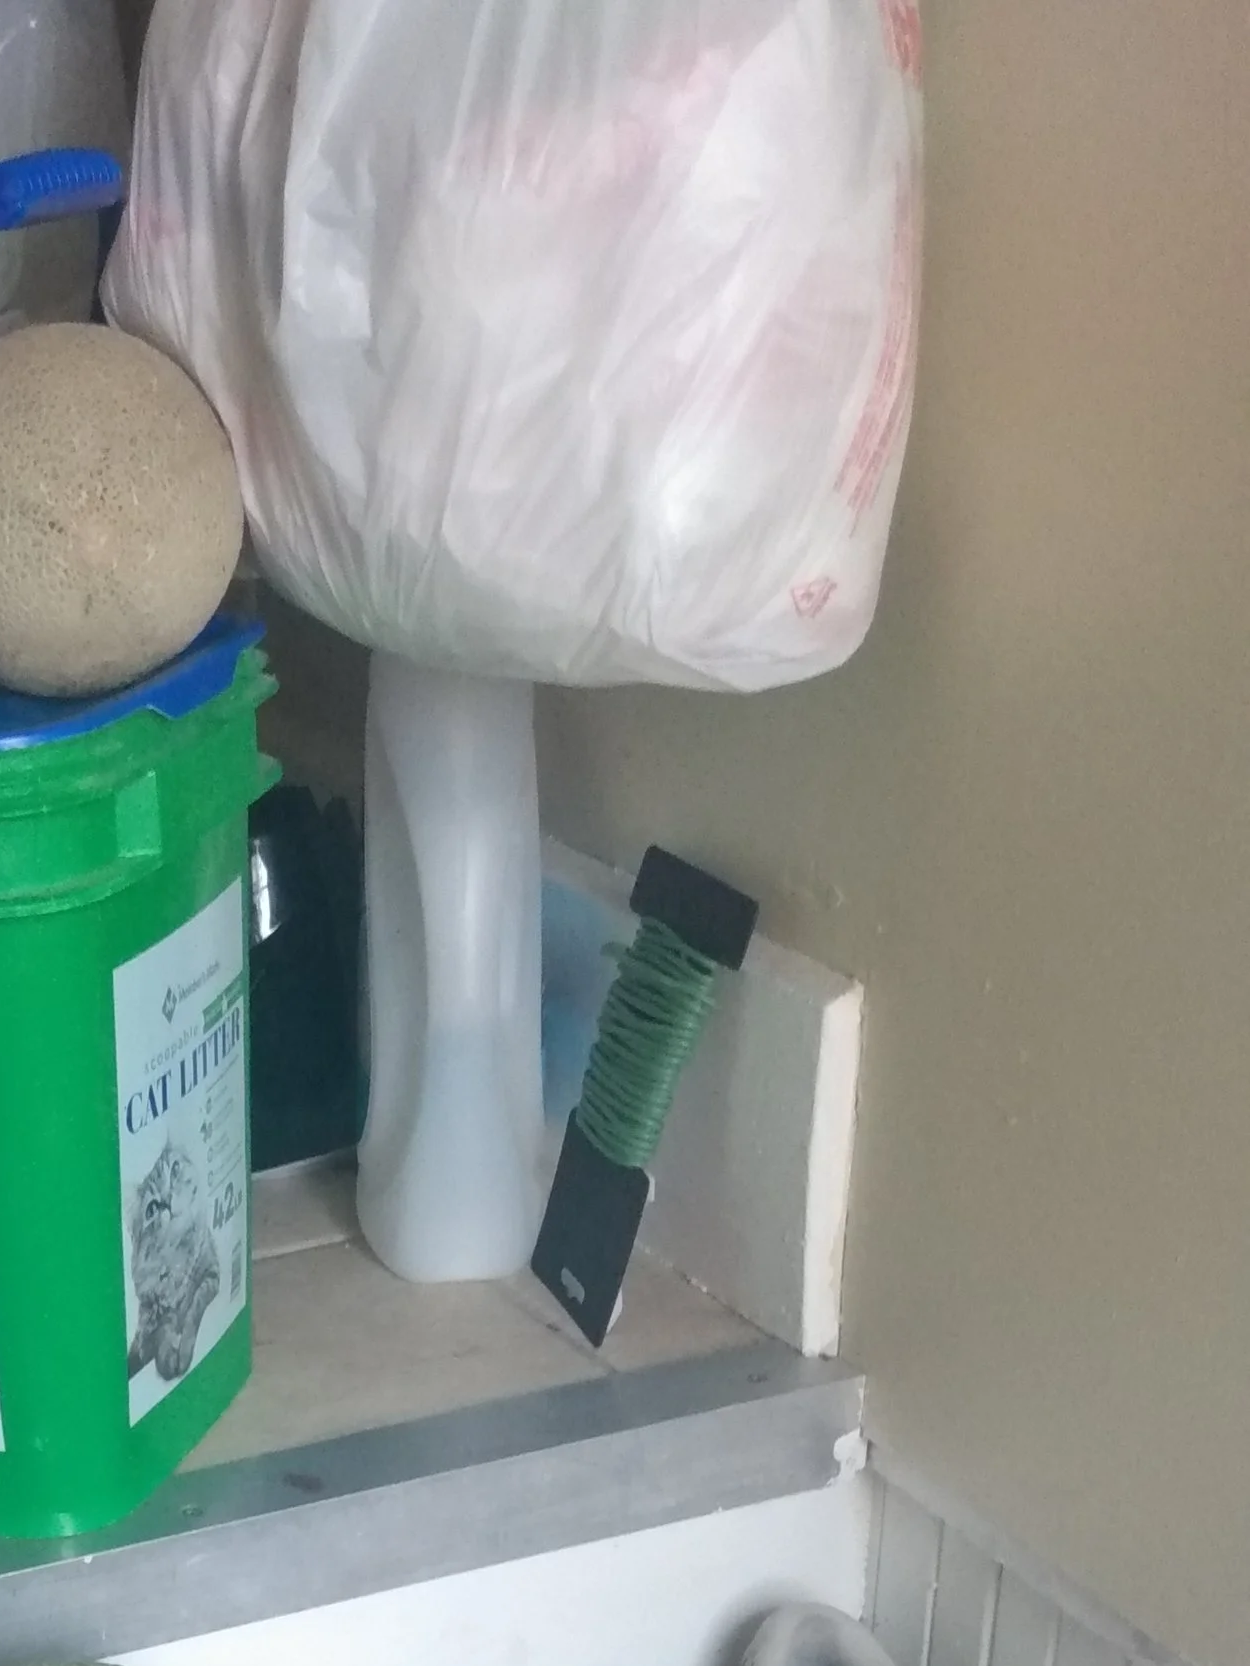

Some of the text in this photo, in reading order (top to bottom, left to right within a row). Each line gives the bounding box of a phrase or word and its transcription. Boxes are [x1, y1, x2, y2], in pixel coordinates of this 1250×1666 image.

[126, 1069, 171, 1135] CAT
[179, 1006, 240, 1098] LITTER
[144, 1024, 199, 1075] scoopable
[213, 1182, 234, 1230] 42
